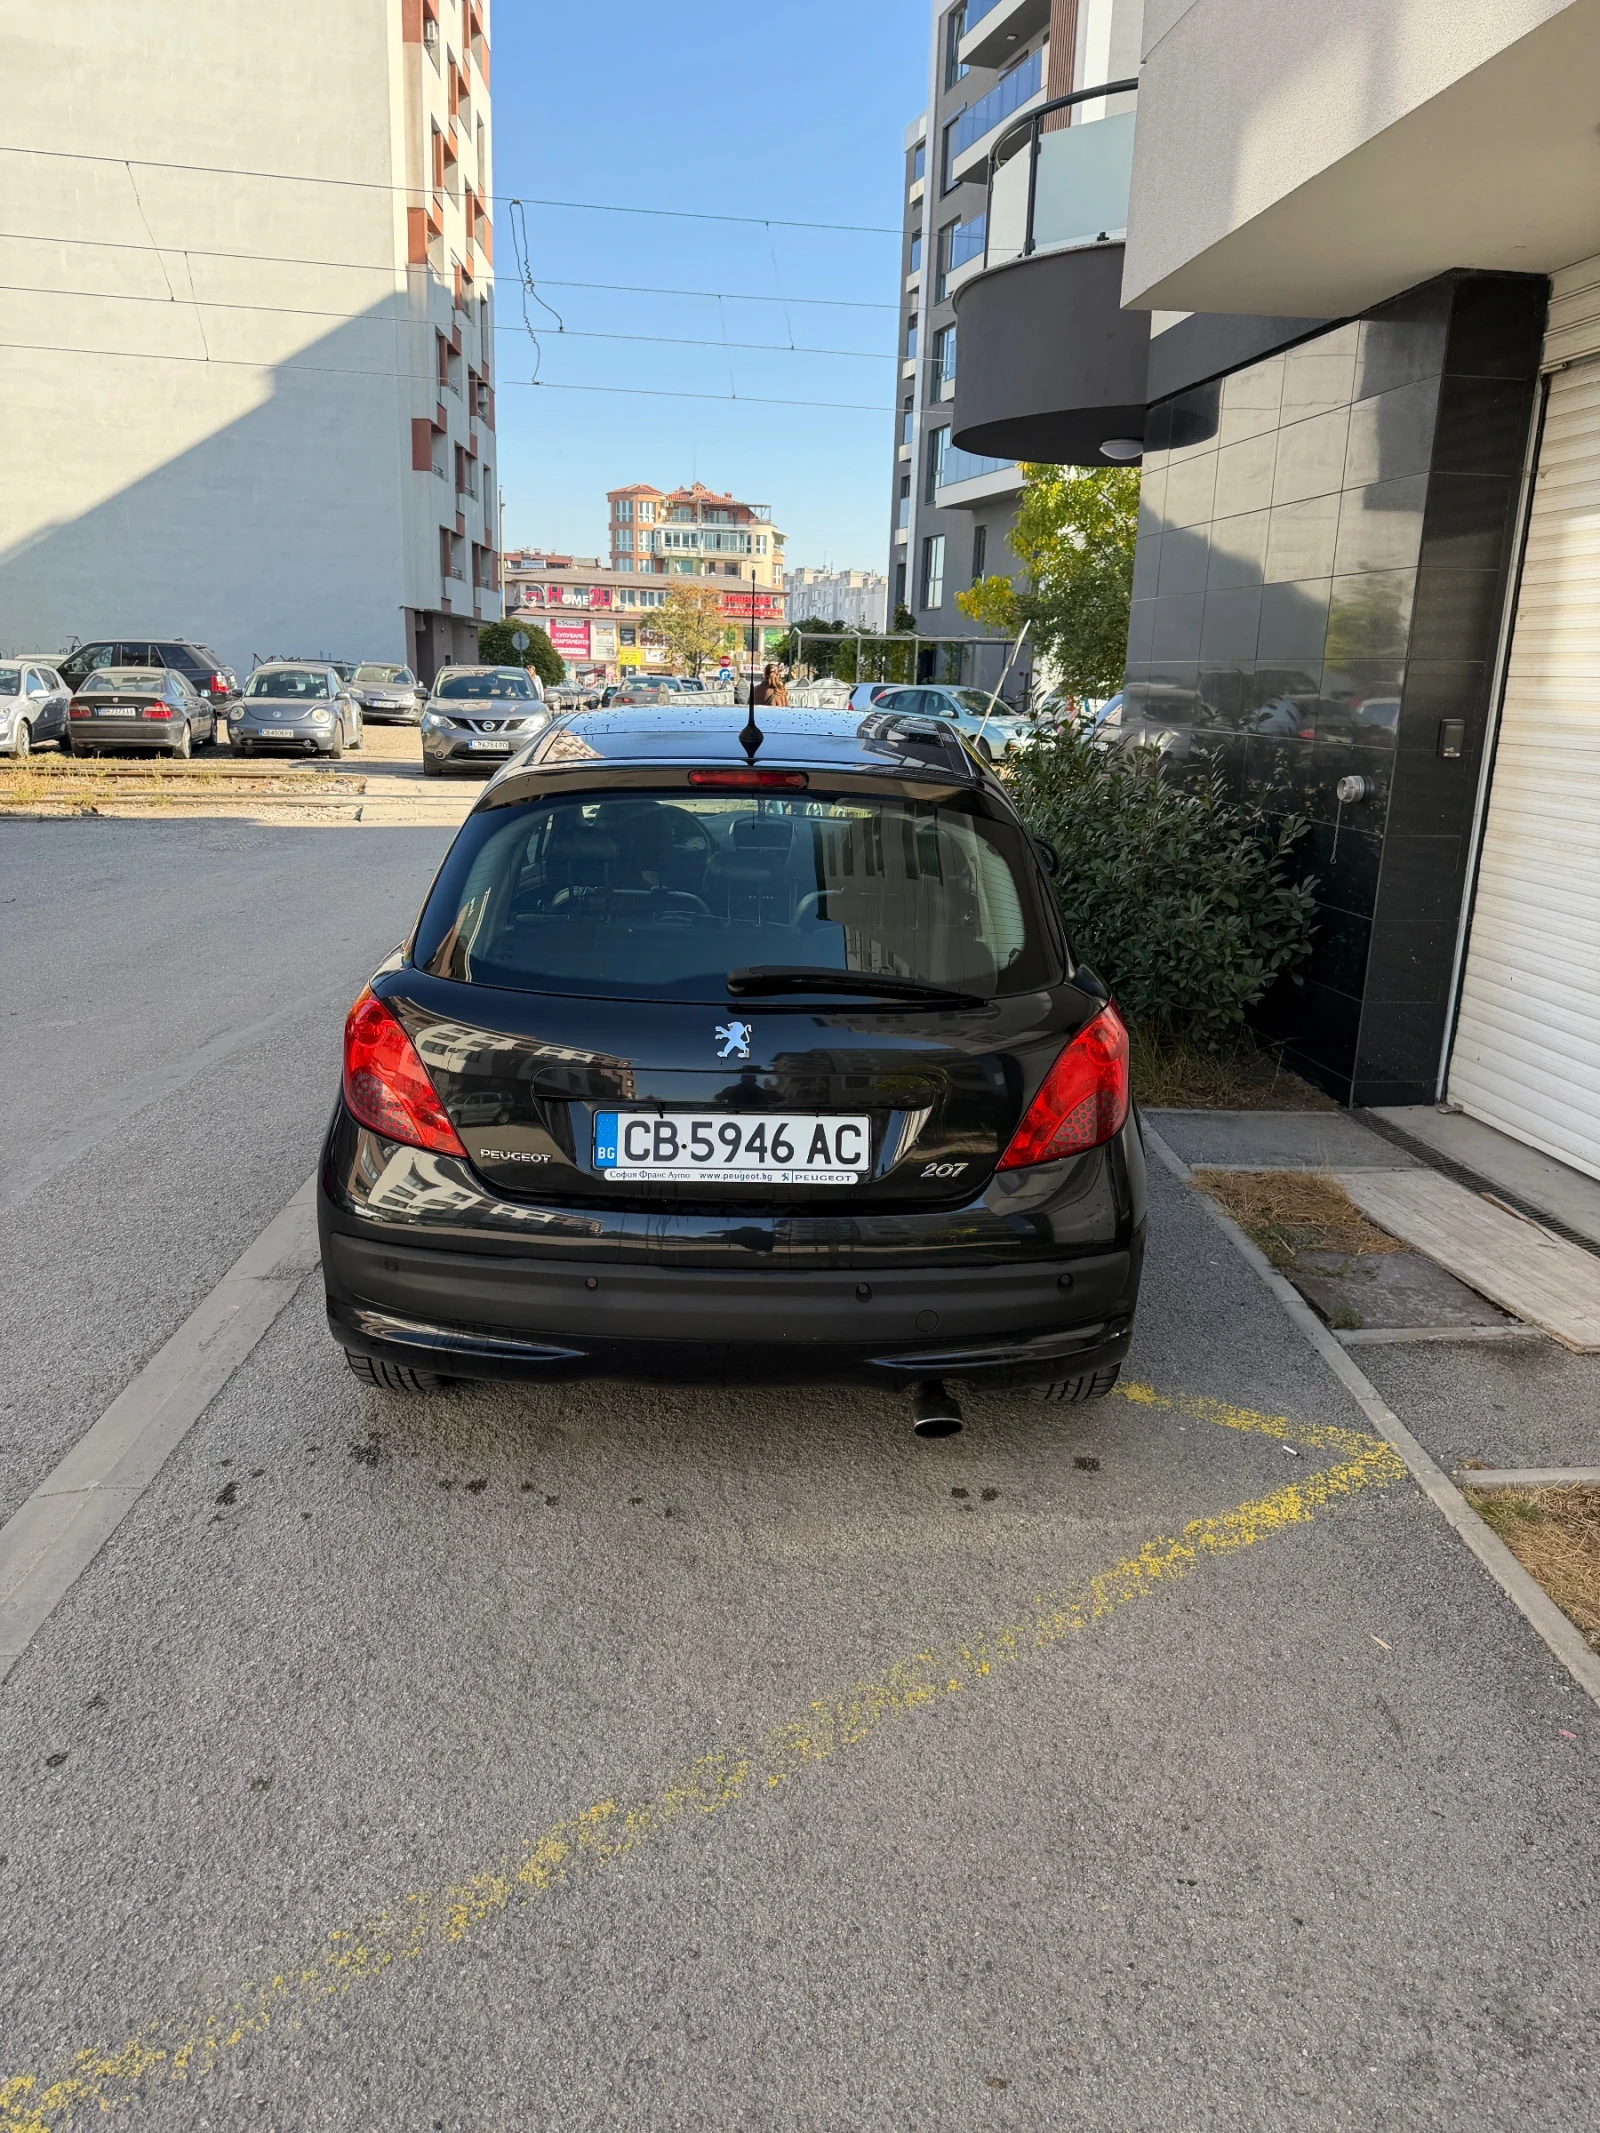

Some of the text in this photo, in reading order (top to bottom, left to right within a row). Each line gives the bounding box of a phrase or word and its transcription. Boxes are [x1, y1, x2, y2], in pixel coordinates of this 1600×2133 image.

[624, 1120, 862, 1165] CB 5946 AC
[480, 1148, 552, 1164] PEUGEOT
[597, 1147, 616, 1160] BG
[609, 1170, 637, 1180] София
[639, 1170, 667, 1180] Франс
[920, 1162, 969, 1178] 207
[699, 1172, 773, 1182] www.peugeot.bg
[795, 1174, 852, 1182] PEUGEOT
